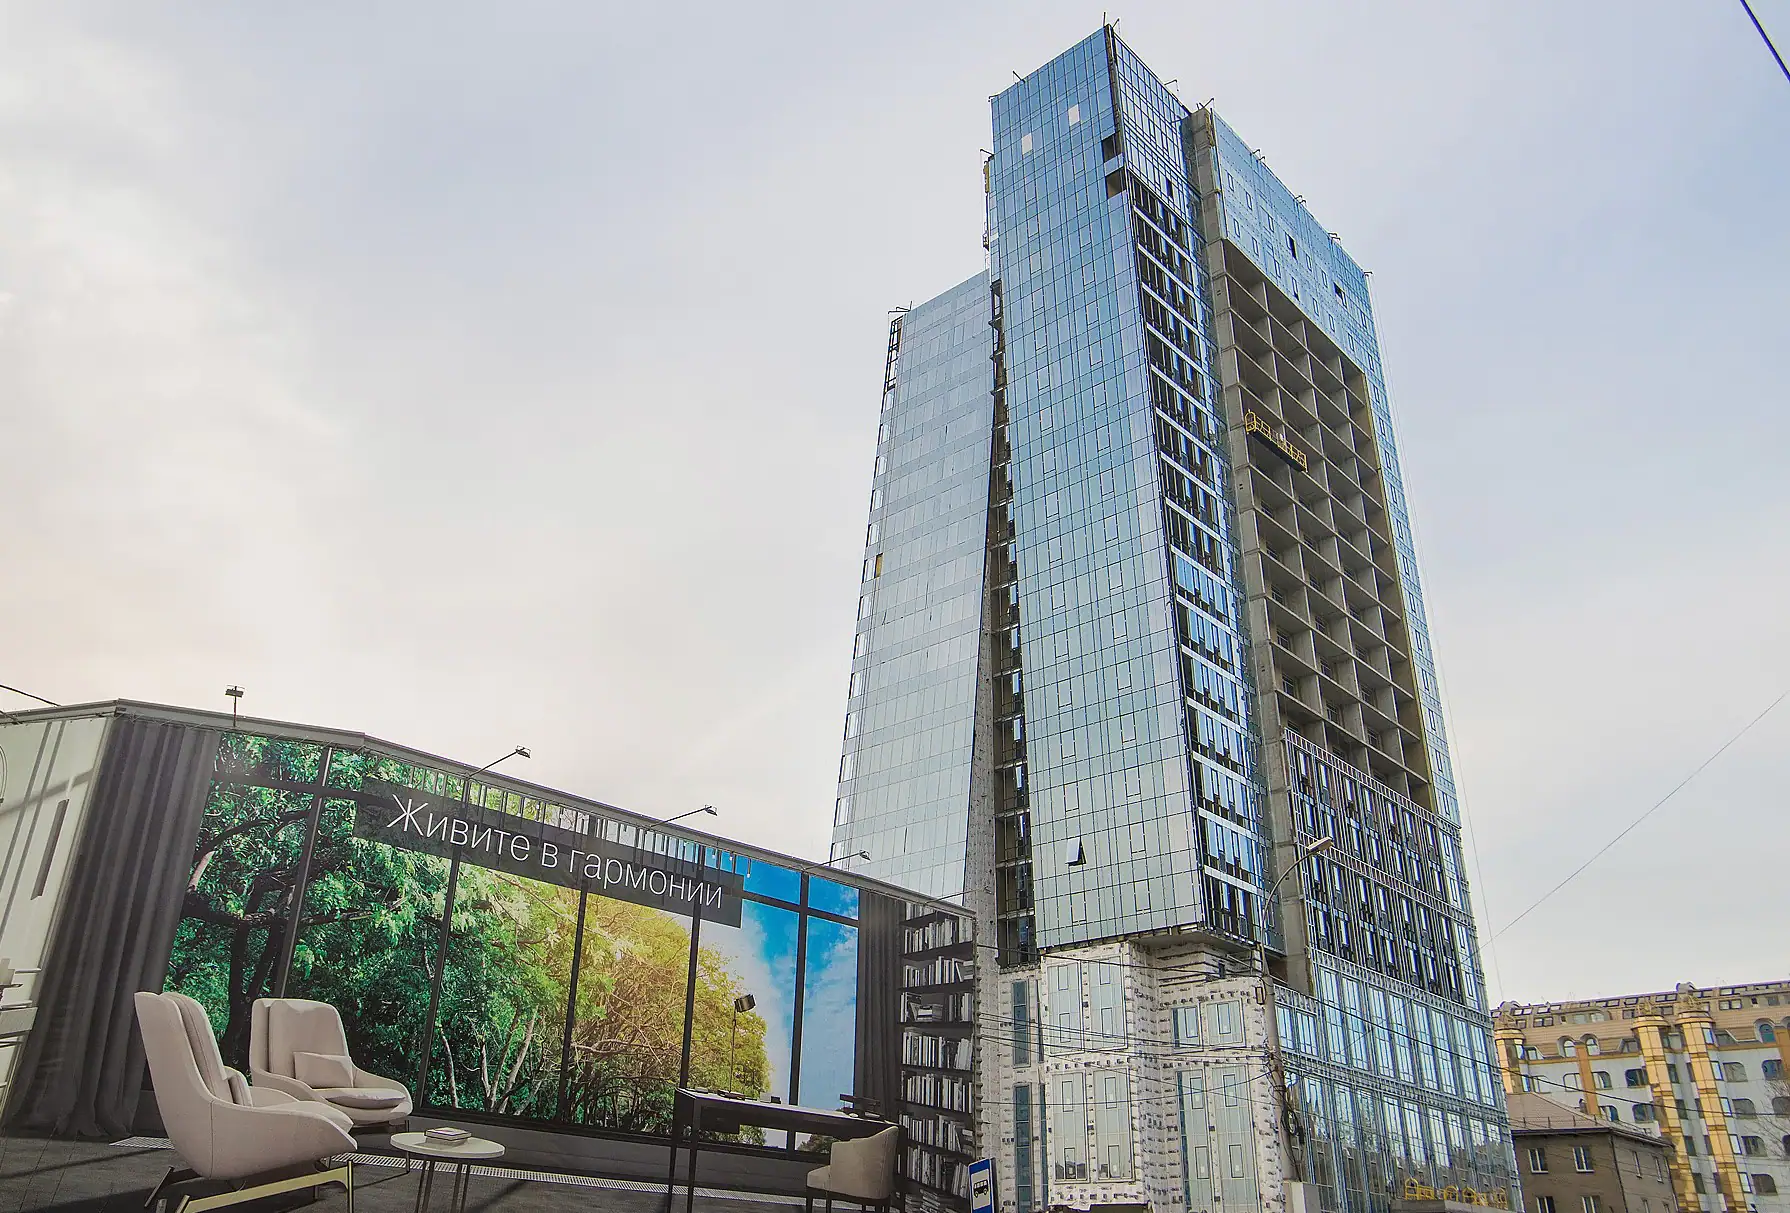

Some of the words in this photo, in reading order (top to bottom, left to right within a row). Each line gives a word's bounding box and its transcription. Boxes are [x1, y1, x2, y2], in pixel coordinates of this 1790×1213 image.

[387, 794, 530, 862] Живите
[541, 843, 558, 868] в
[569, 849, 722, 908] гармонии
